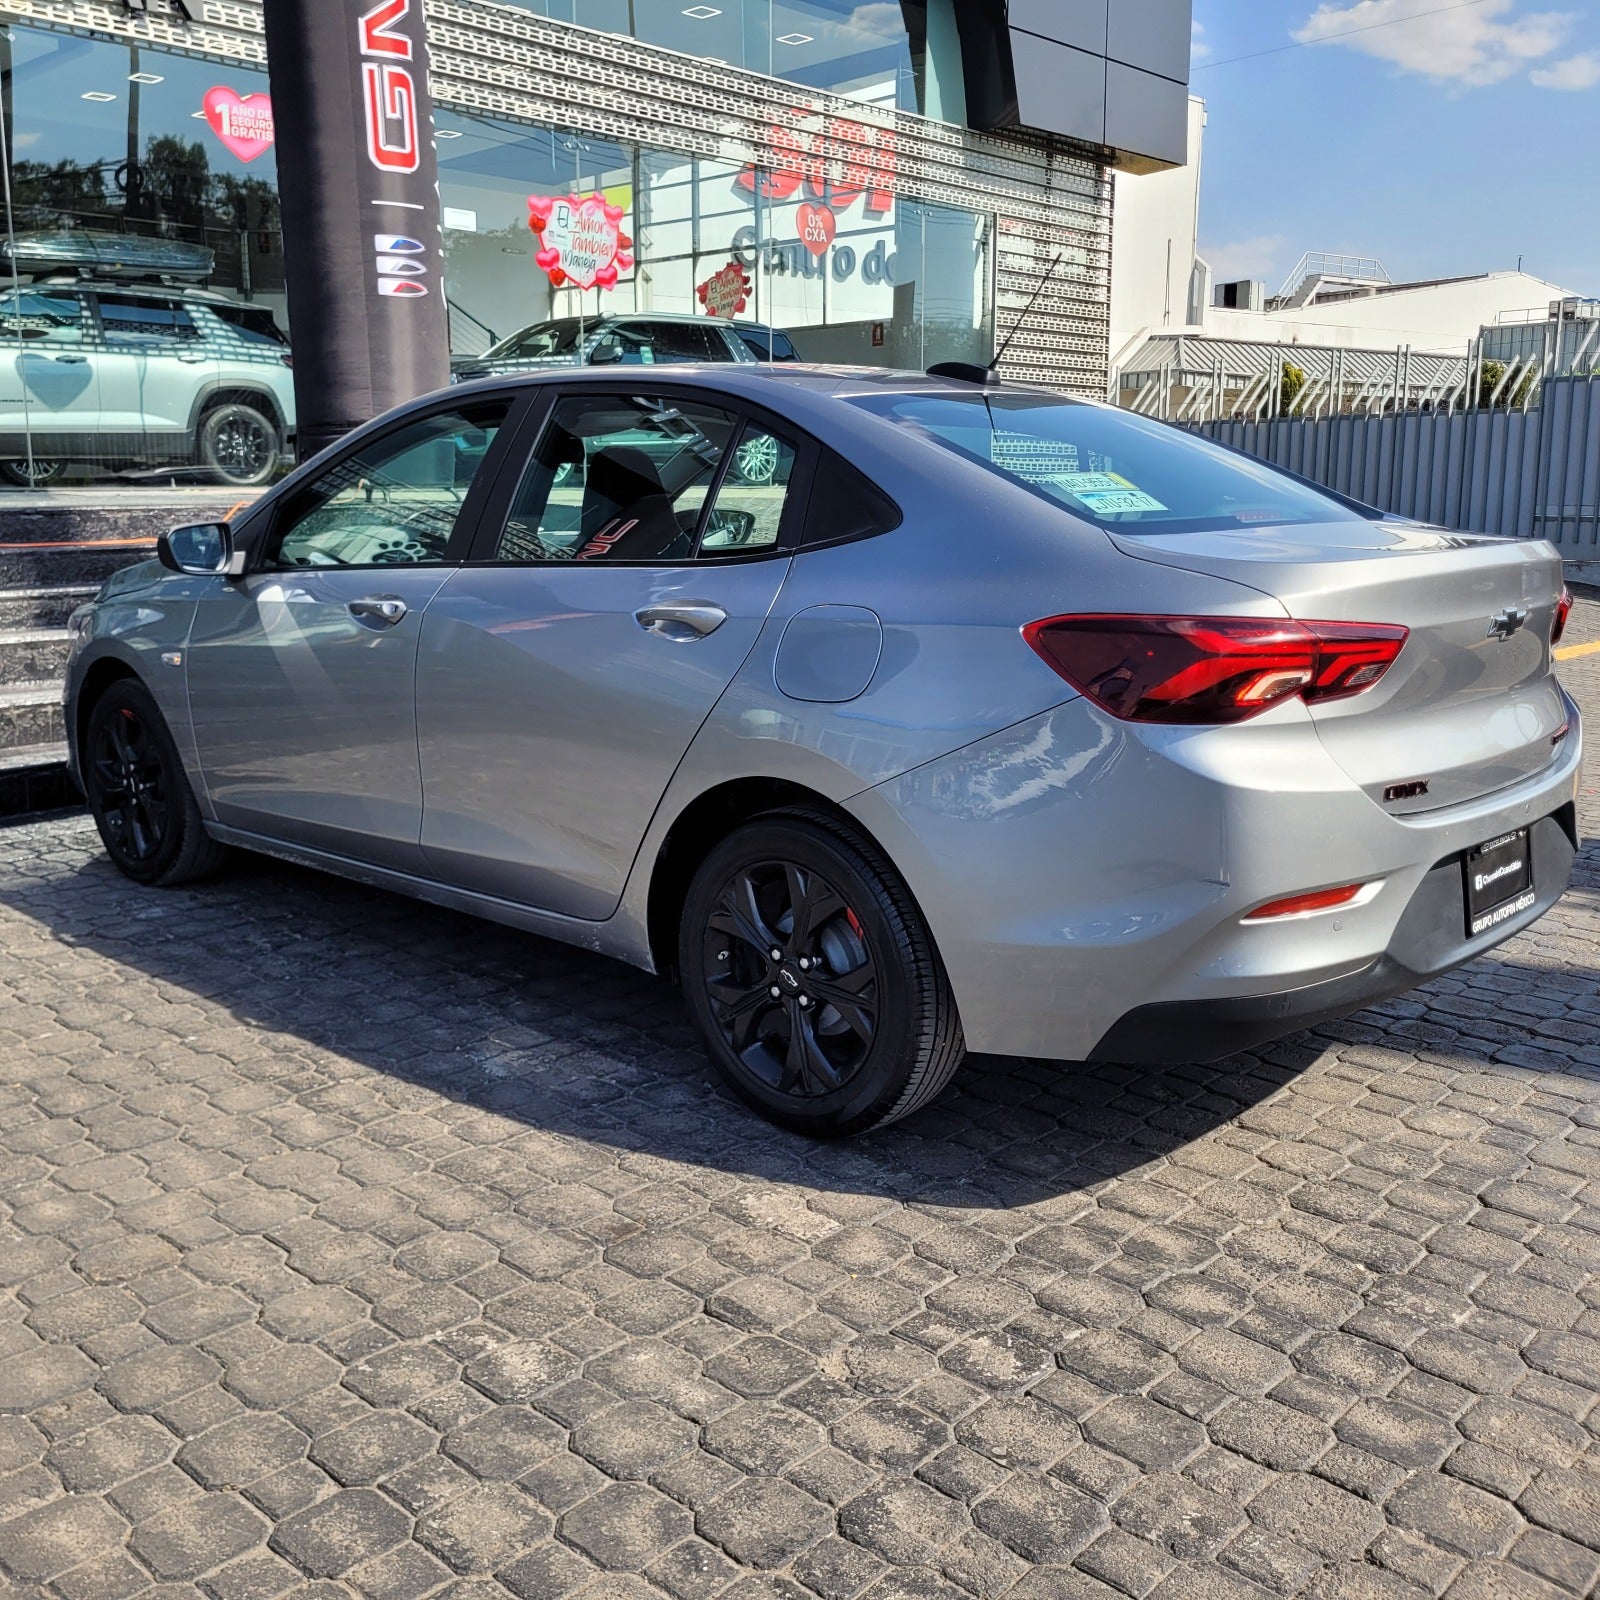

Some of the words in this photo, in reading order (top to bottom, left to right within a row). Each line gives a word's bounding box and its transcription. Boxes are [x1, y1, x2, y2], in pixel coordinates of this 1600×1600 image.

[215, 103, 231, 136] 1
[232, 104, 256, 118] AÑO
[257, 108, 272, 121] DE
[231, 115, 274, 131] SEGURO
[231, 125, 274, 142] GRATIS
[574, 210, 607, 235] Amor
[807, 214, 824, 229] 0%
[804, 227, 828, 243] CXA
[561, 249, 597, 274] Maneja
[1472, 913, 1493, 934] GRUPO
[1492, 902, 1516, 924] AUTOFIN
[1515, 892, 1535, 912] MÉXICO
